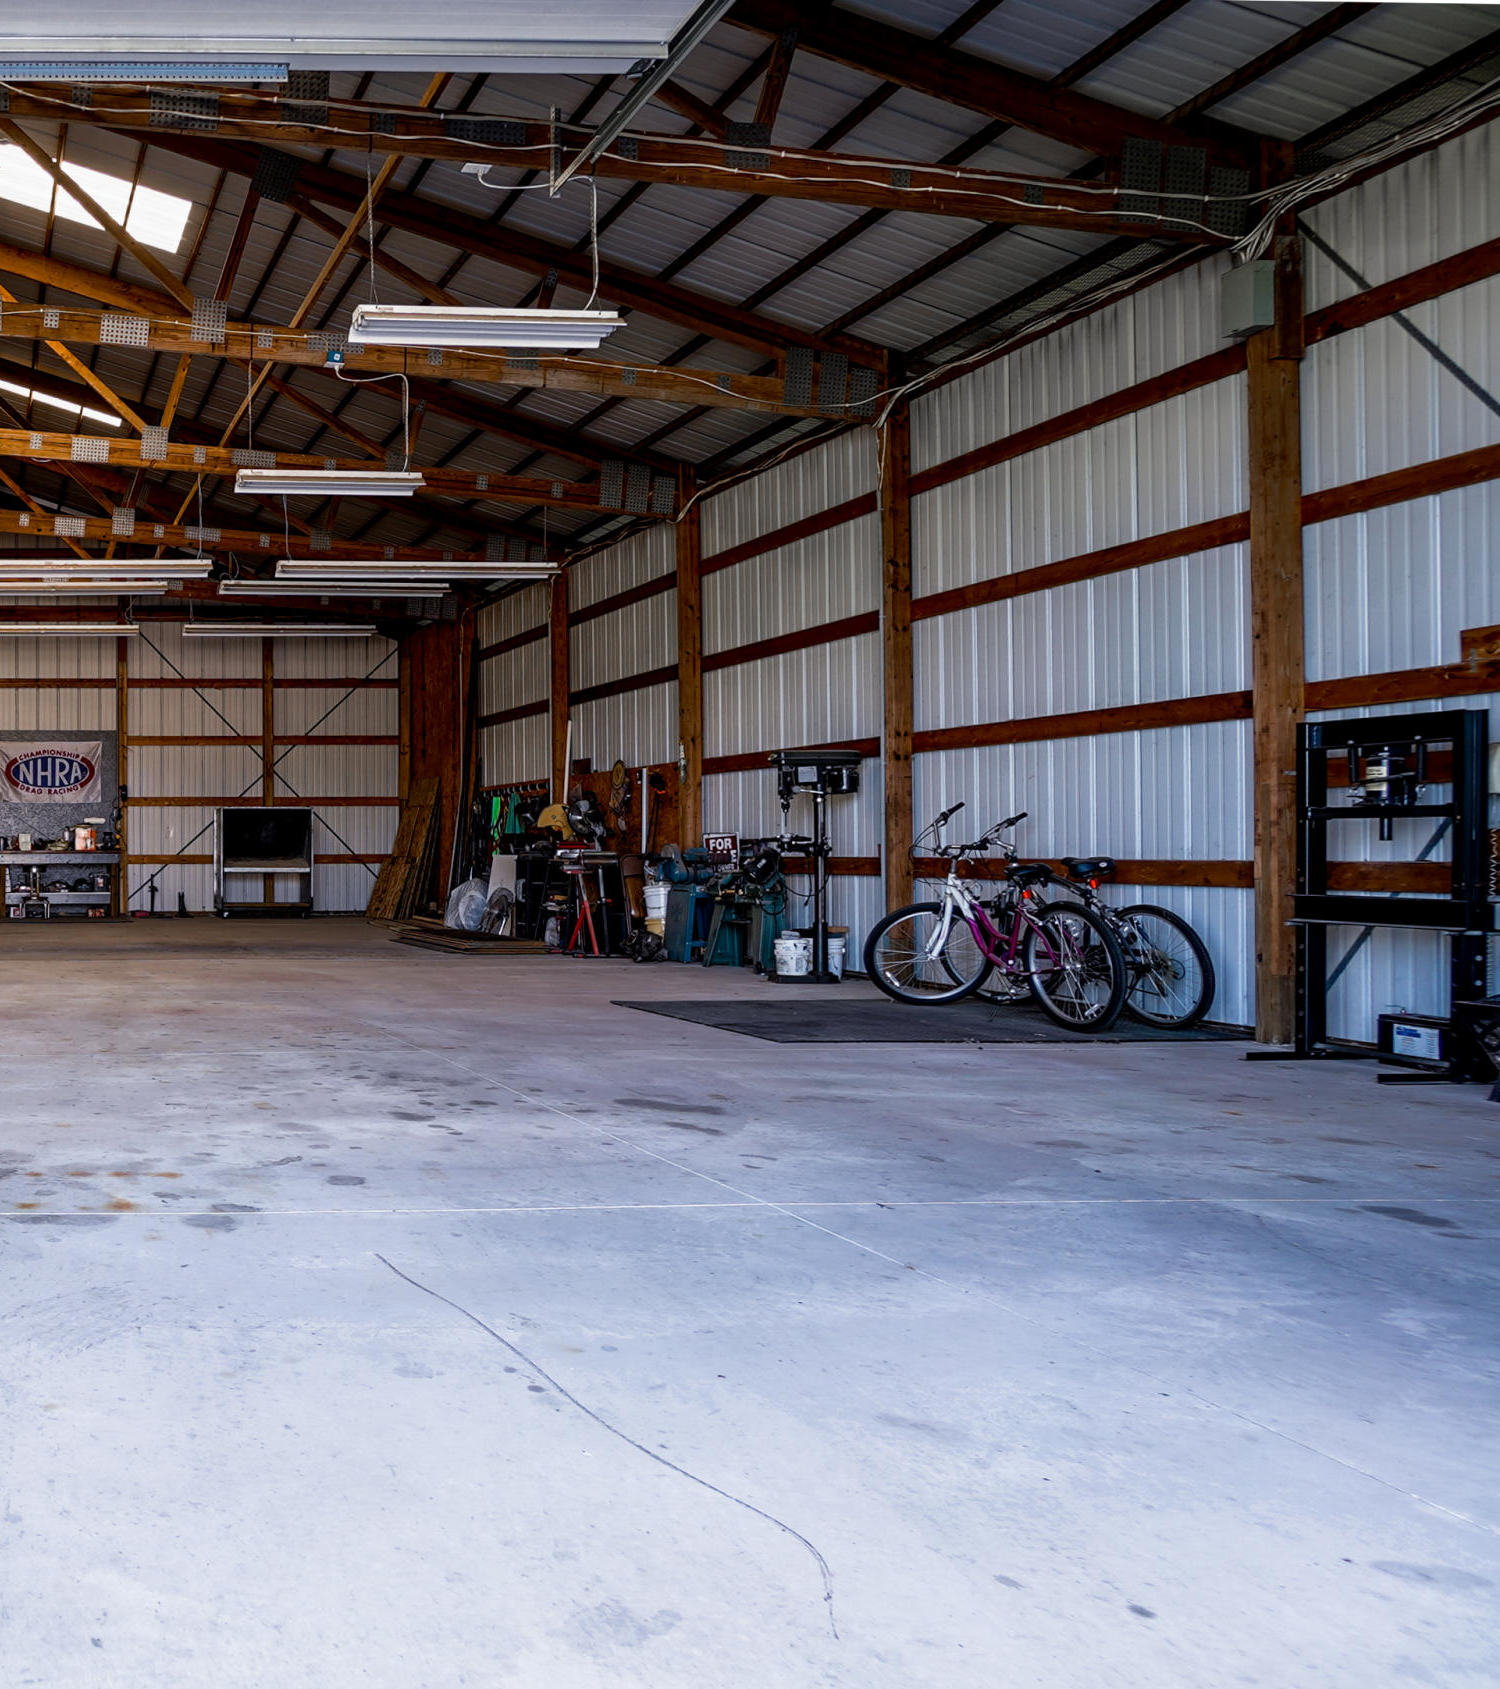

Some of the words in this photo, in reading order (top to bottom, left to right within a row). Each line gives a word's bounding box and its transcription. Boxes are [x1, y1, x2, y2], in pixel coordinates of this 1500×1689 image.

[18, 749, 81, 761] CHAMPIONSHIP
[19, 757, 82, 787] NHRA
[19, 784, 43, 795] DRAG
[47, 784, 79, 796] RACING
[709, 837, 732, 851] FOR
